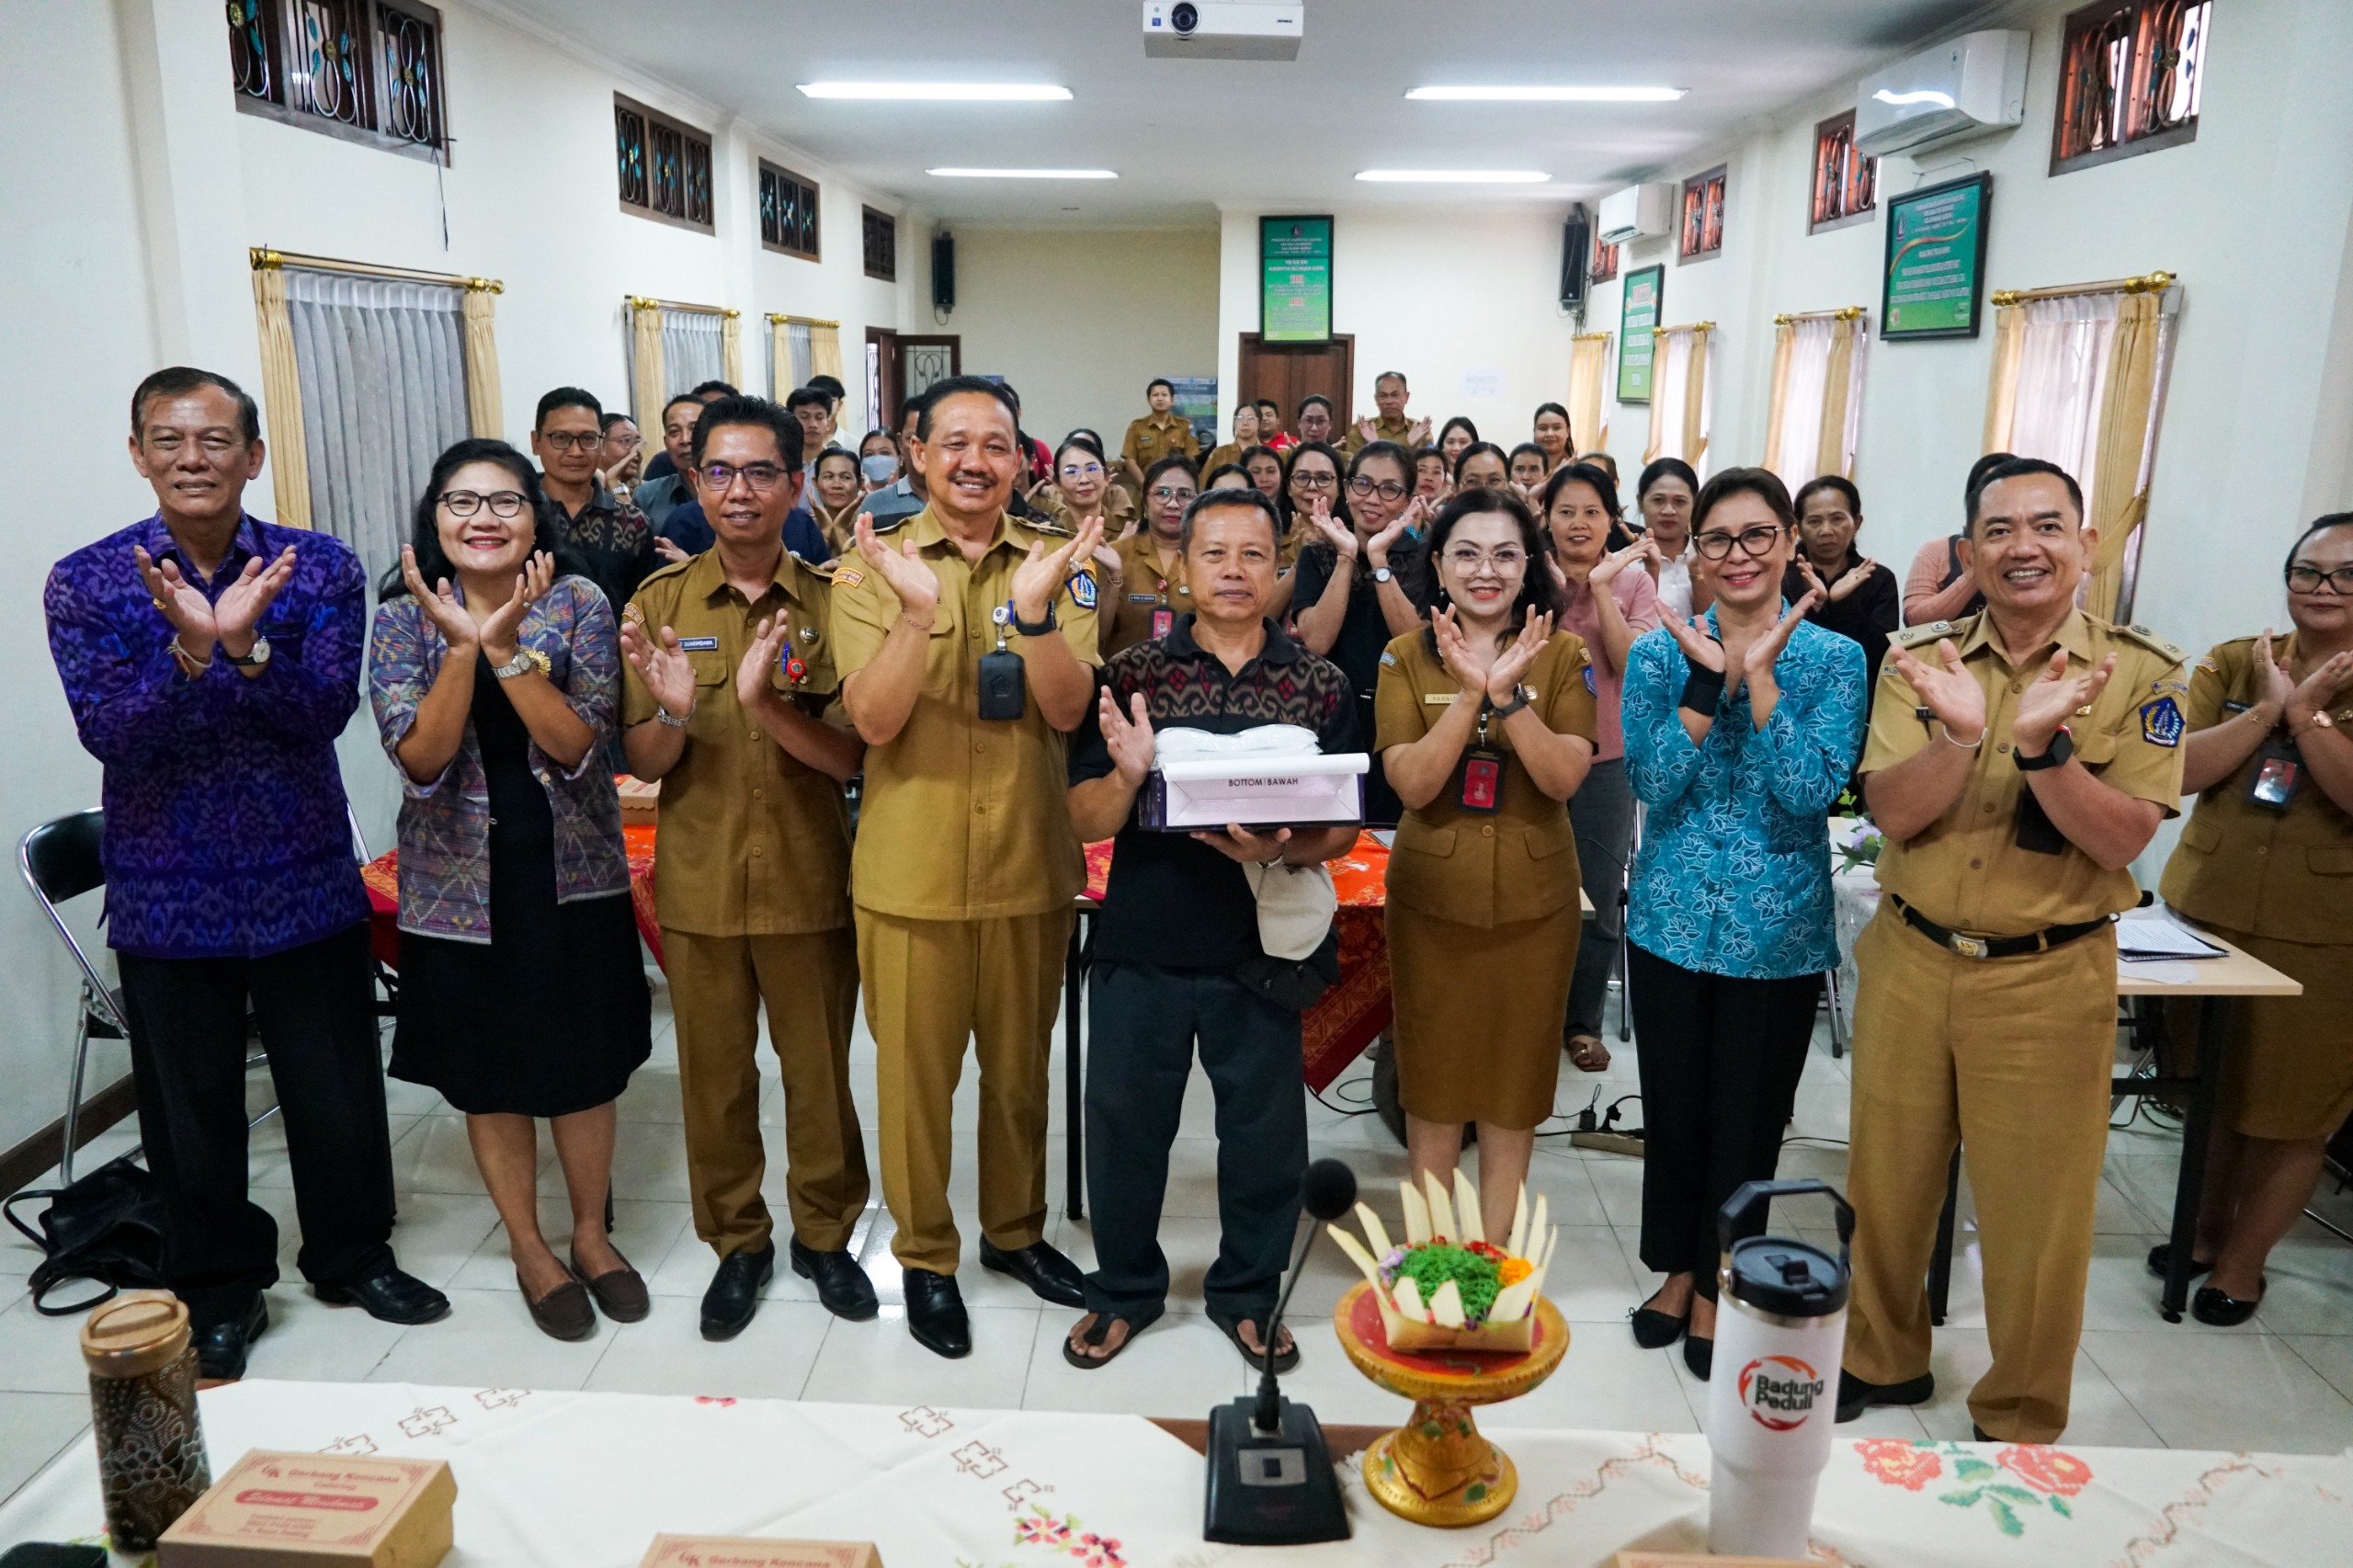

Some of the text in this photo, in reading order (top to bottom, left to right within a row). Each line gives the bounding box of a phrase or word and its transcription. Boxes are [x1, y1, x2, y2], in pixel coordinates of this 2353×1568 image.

[1228, 778, 1299, 787] BOTTOM BAWAH
[1756, 1374, 1824, 1395] Badung
[1755, 1390, 1812, 1410] Peduli
